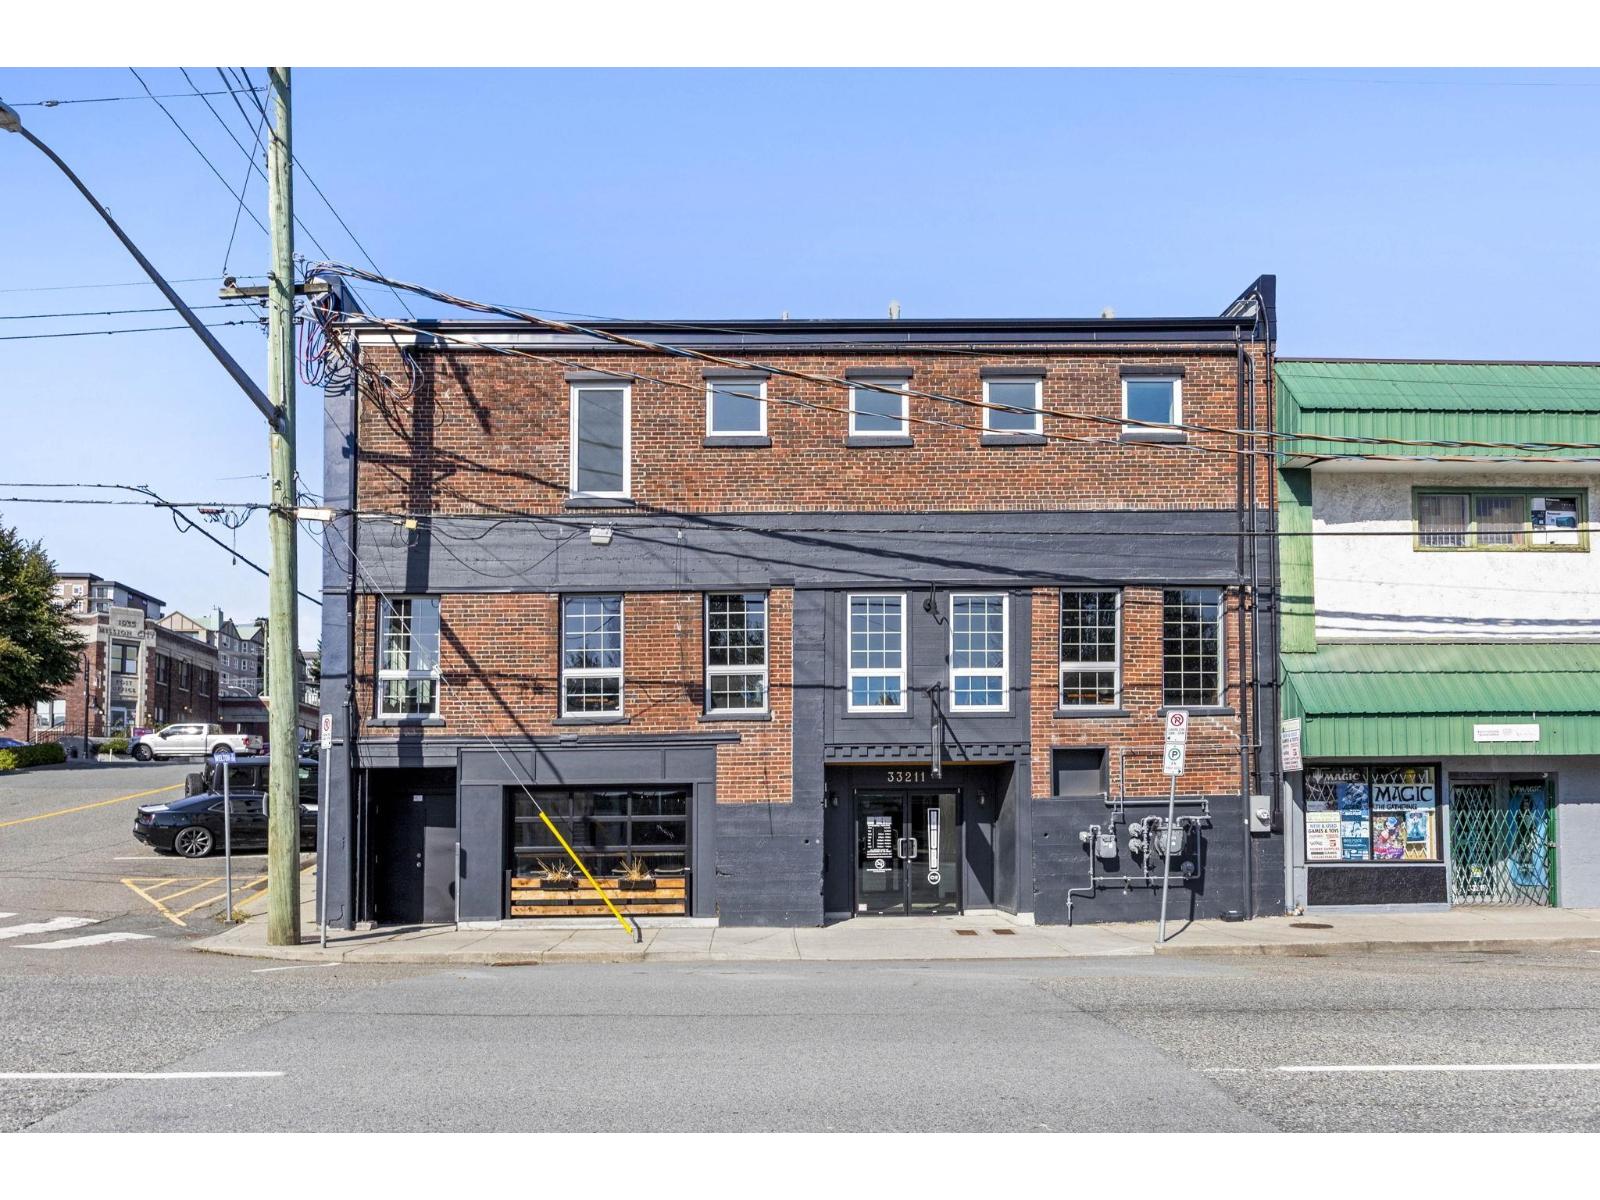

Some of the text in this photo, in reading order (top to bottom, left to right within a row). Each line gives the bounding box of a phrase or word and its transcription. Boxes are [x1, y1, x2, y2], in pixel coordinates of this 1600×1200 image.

[99, 626, 132, 636] MISSION
[887, 771, 925, 782] 33211
[1324, 773, 1360, 781] MAGIC
[1375, 786, 1433, 802] MAGIC
